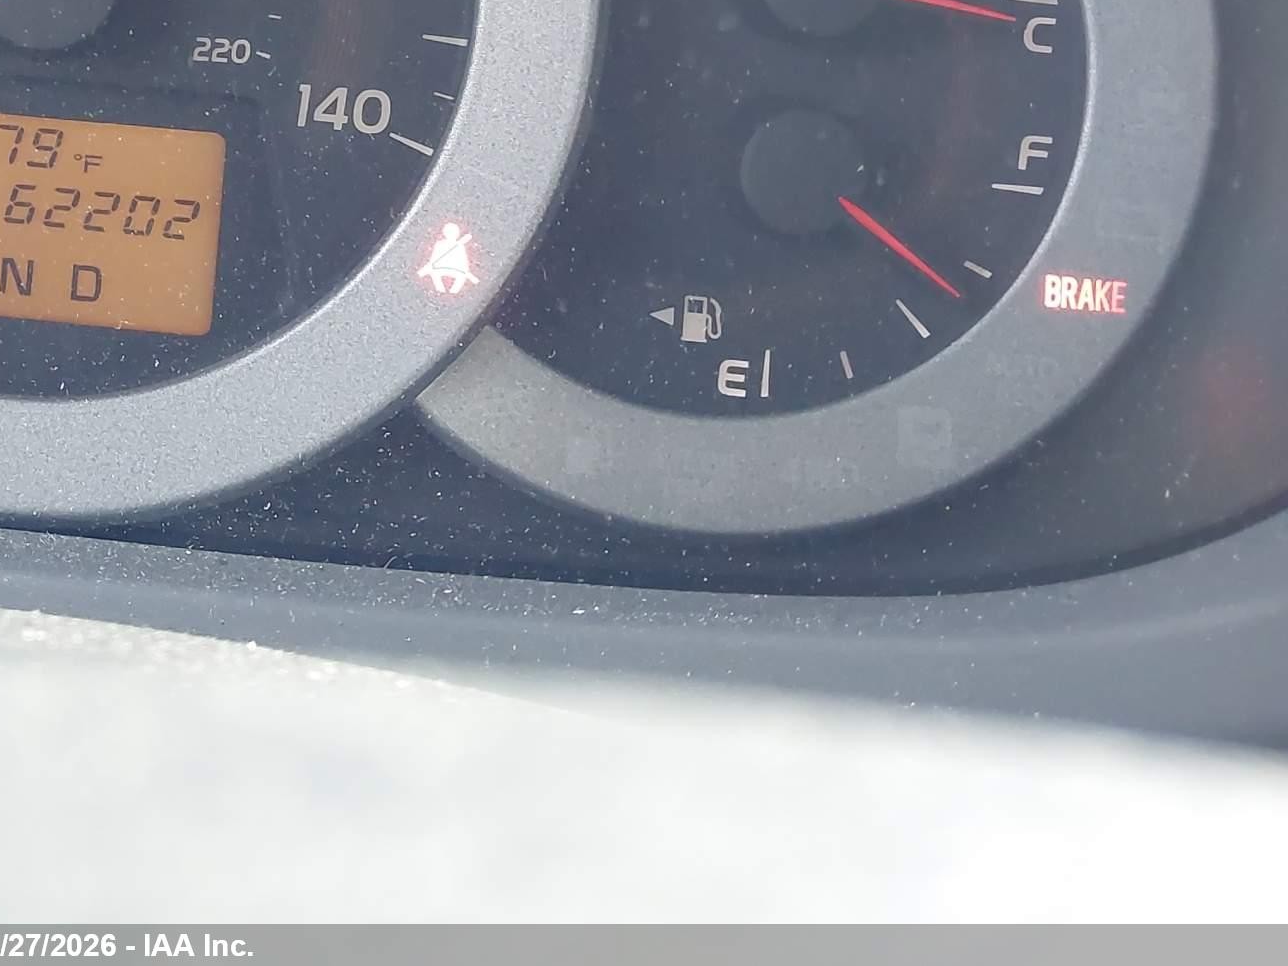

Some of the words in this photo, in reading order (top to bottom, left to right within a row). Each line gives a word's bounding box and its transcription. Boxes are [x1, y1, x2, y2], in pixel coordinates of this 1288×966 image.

[193, 38, 250, 63] 220
[1024, 17, 1056, 53] C
[298, 84, 390, 134] 140
[0, 125, 63, 168] 79
[1018, 136, 1052, 170] F
[4, 185, 200, 240] 62202
[0, 258, 34, 296] N
[70, 264, 102, 302] D
[1044, 274, 1126, 312] BRAKE
[718, 360, 749, 397] E
